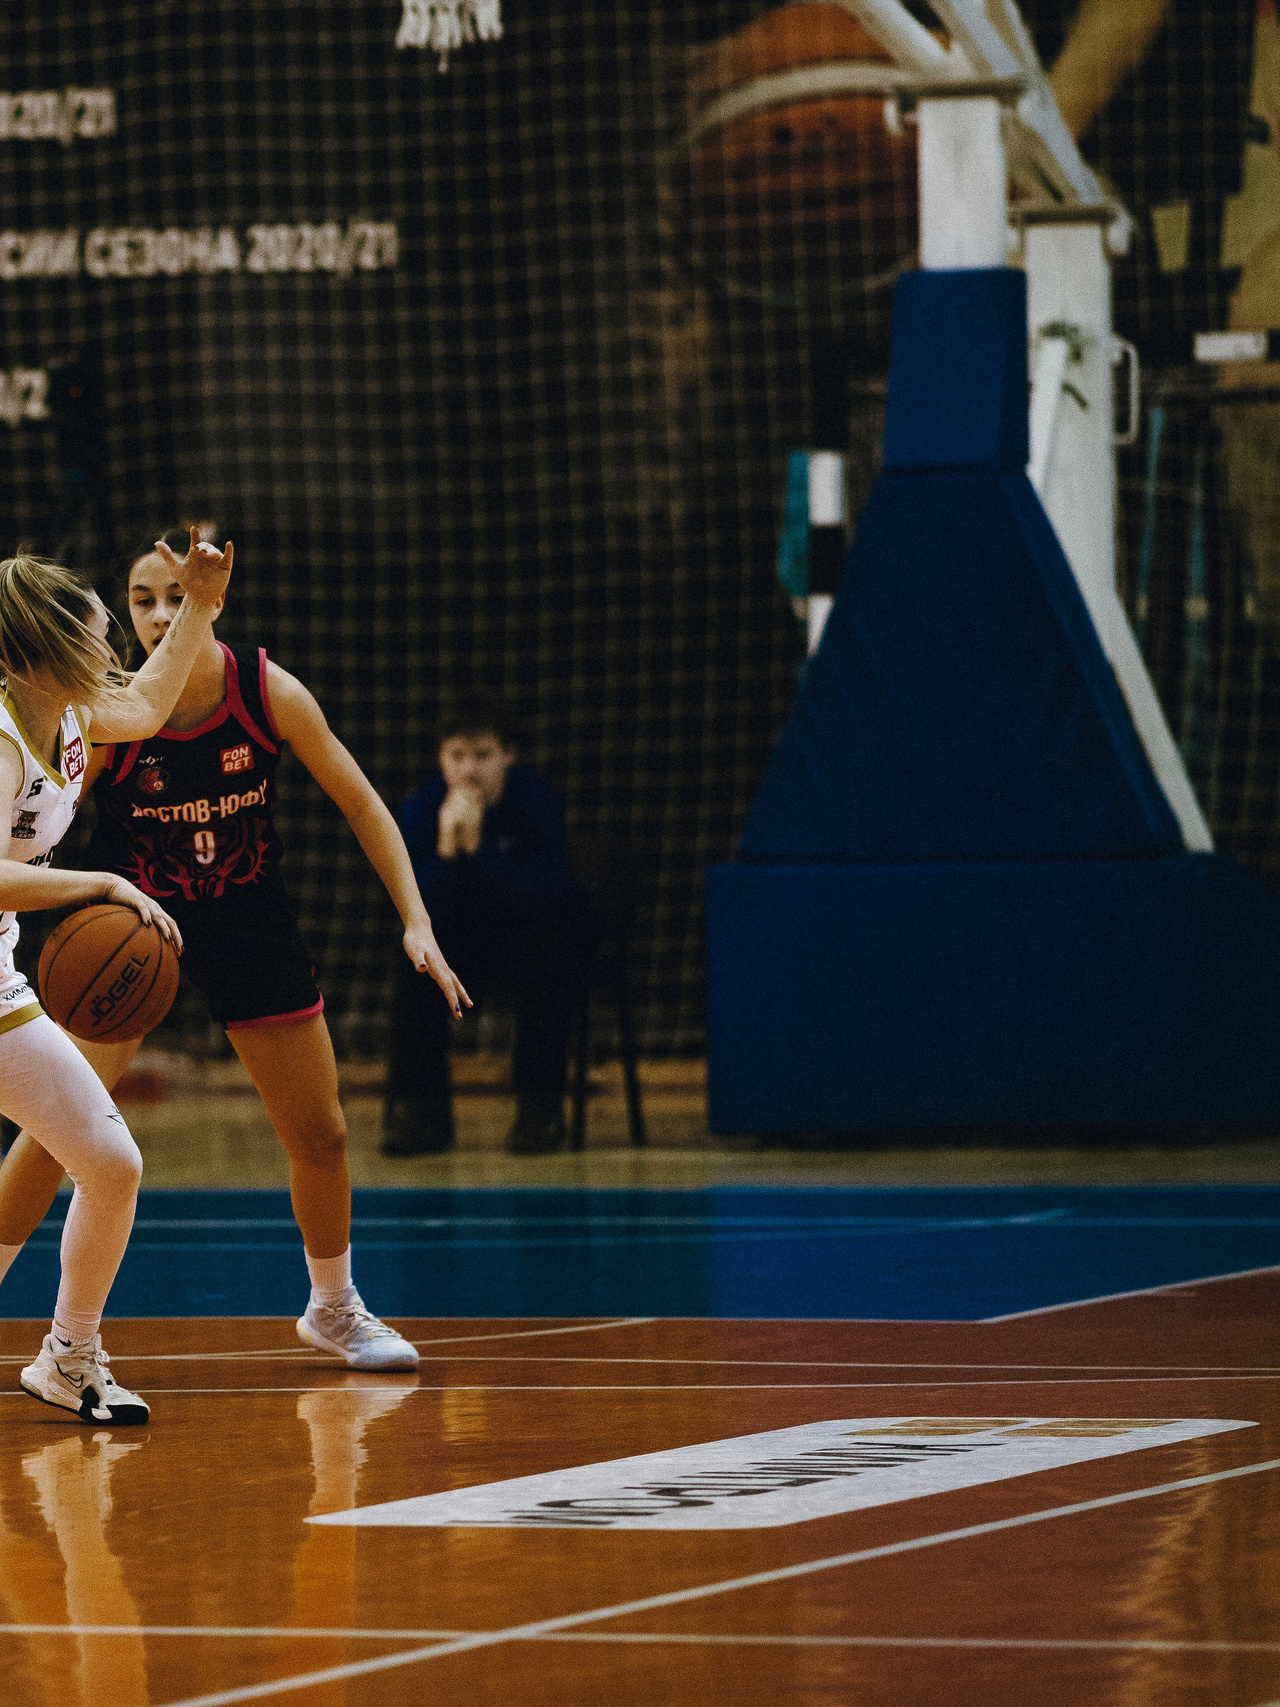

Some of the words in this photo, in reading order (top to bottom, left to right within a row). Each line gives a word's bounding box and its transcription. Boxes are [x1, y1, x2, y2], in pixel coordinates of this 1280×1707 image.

[84, 224, 241, 279] СЕЗОНА
[64, 740, 82, 764] FON
[222, 746, 250, 762] FON
[223, 756, 251, 772] BET
[68, 757, 84, 777] BET
[193, 830, 216, 865] 9
[89, 953, 151, 1027] JÖGEL
[447, 1441, 1007, 1526] ХИМПРОМ
